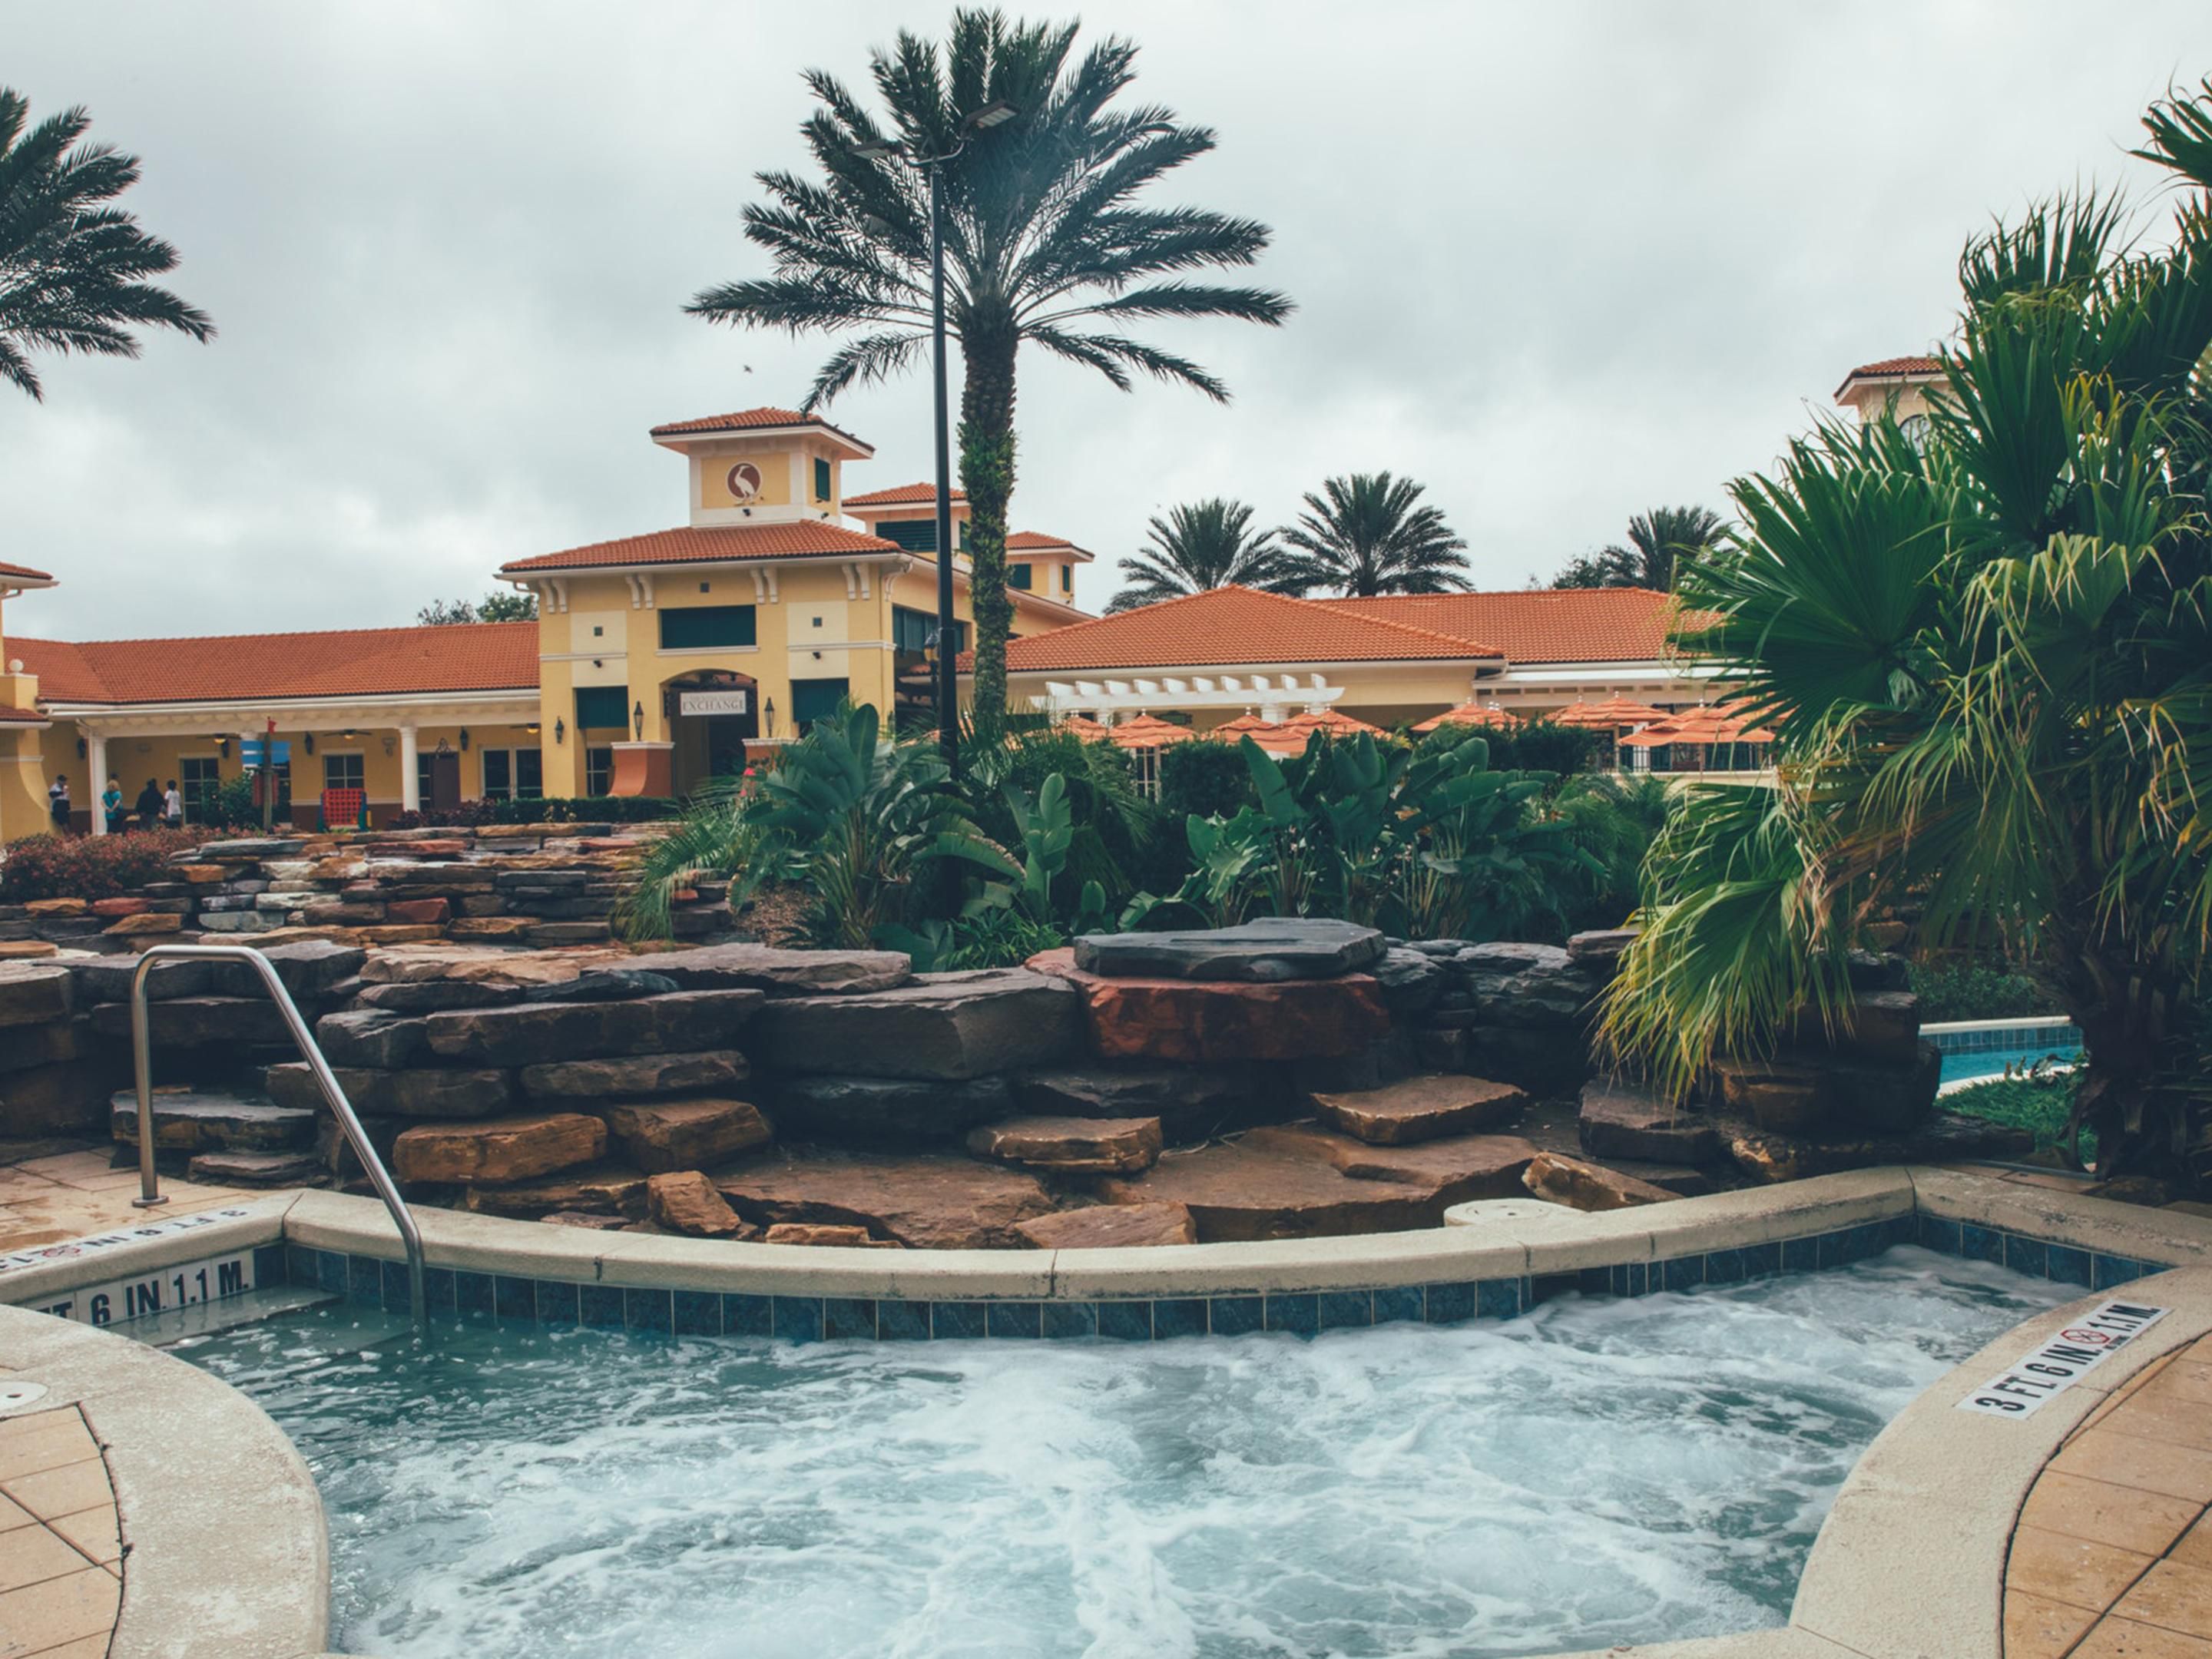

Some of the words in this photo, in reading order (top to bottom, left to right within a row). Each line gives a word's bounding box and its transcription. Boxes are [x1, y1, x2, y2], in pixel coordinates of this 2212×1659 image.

[682, 699, 745, 711] EXCHANGE
[90, 1293, 111, 1327] 6
[125, 1280, 167, 1317] IN.
[173, 1268, 208, 1305] 1.1
[218, 1260, 249, 1295] M.
[2087, 1314, 2142, 1332] 1.1
[2040, 1344, 2103, 1366] IN.
[2025, 1363, 2074, 1377] 6
[1975, 1396, 2026, 1412] 3
